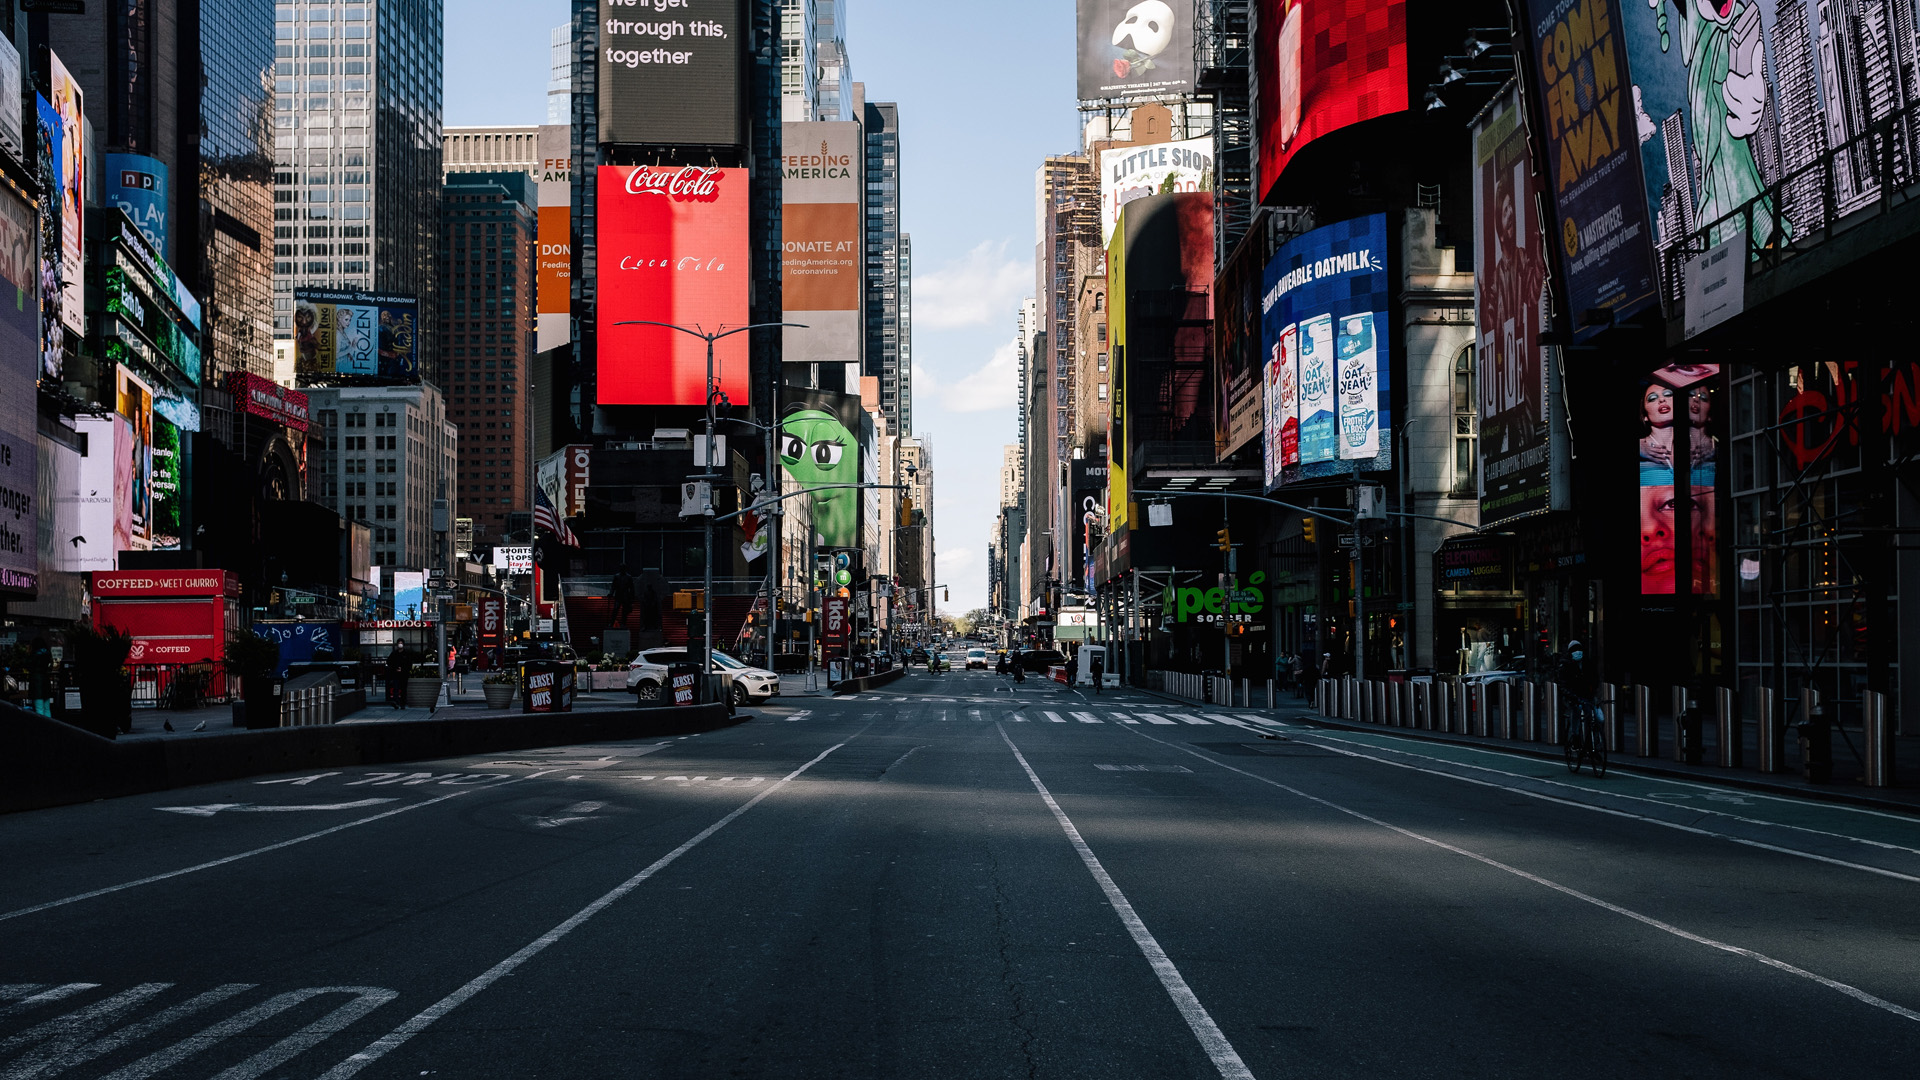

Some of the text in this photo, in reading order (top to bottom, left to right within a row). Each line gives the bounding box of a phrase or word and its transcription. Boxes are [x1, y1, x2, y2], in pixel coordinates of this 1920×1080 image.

[606, 19, 728, 40] through this,
[1538, 10, 1555, 38] COME
[1541, 0, 1611, 86] COME
[606, 48, 693, 68] together
[1559, 88, 1620, 193] AWAY
[1114, 148, 1212, 183] LITTLE SHOP
[125, 174, 162, 190] npr
[1559, 150, 1628, 208] THE REMARKABLE TRUE STORY
[1584, 203, 1623, 247] MASTERPIECE!
[781, 241, 853, 252] ONATE AT
[1314, 249, 1370, 279] OATMILK
[323, 292, 354, 300] BROADWAY,
[355, 292, 376, 302] Disney
[387, 296, 416, 304] BROADWAY
[320, 307, 331, 369] THE LION KING
[352, 309, 374, 370] FROZEN
[392, 312, 413, 373] Aladdin
[1305, 360, 1324, 382] OAT
[1344, 364, 1364, 380] OAT
[1302, 378, 1327, 401] YEAH
[1340, 377, 1368, 395] YEAH
[1446, 564, 1502, 578] CAMERA LUGGAGE
[1558, 556, 1574, 567] SONY
[97, 578, 154, 589] COFFEED
[159, 578, 183, 588] SWEET
[184, 578, 218, 588] CHURROS
[484, 600, 500, 631] tkts
[828, 600, 844, 631] tkts
[1196, 614, 1252, 622] SOCER
[528, 672, 554, 690] JERSEY
[672, 674, 695, 688] JERSEY
[531, 690, 552, 708] BOYS
[674, 689, 693, 703] BOYS
